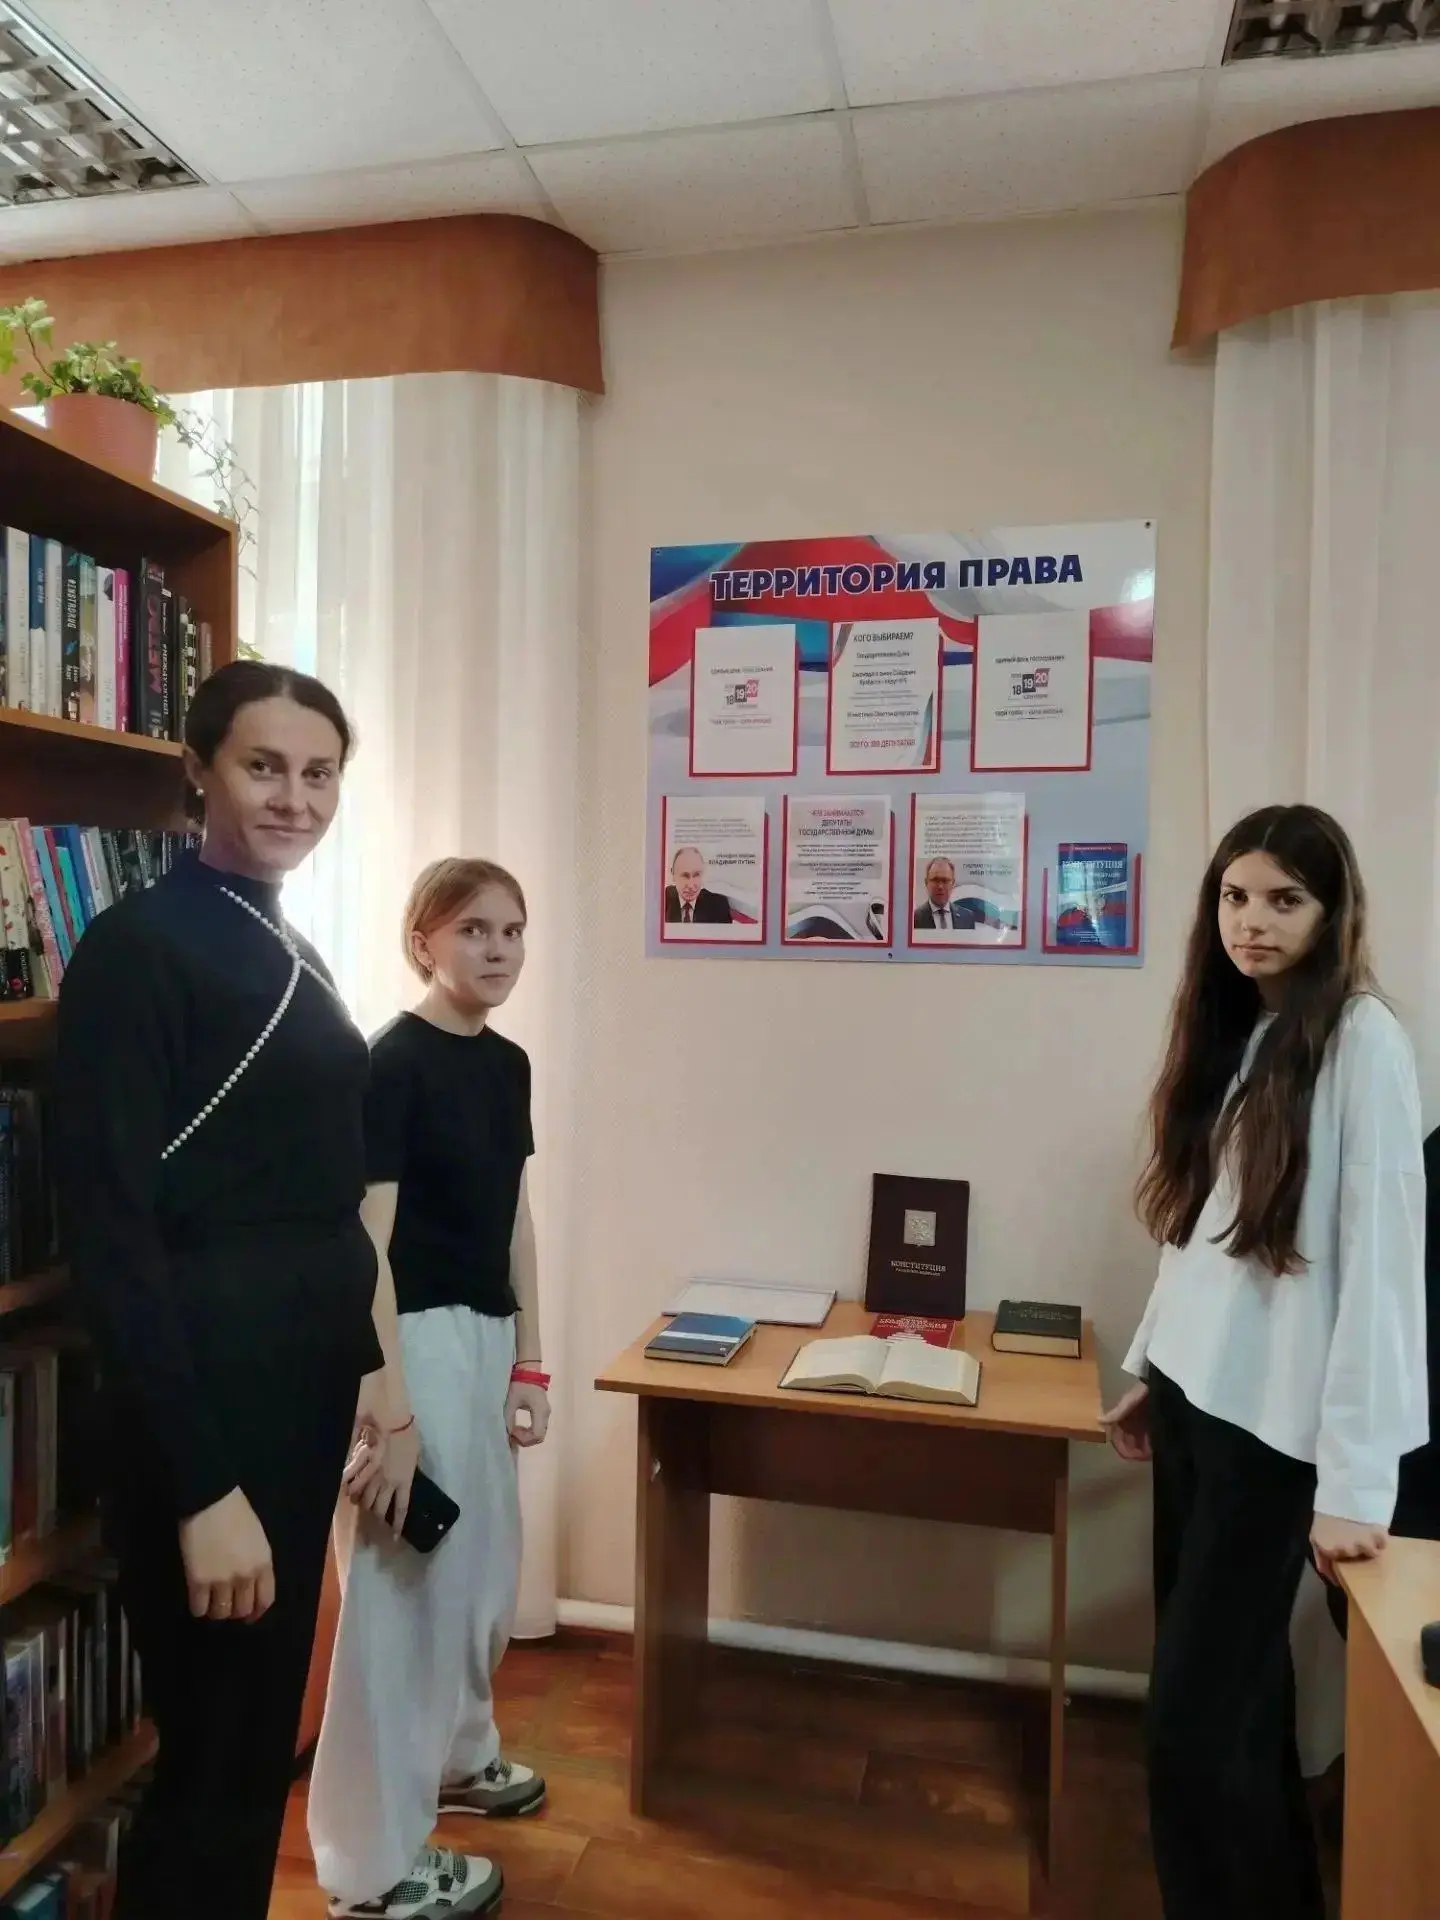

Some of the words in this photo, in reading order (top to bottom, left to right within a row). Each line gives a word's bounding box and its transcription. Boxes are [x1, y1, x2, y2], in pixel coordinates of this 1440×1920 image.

[711, 560, 946, 600] ТЕРРИТОРИЯ
[959, 554, 1083, 588] ПРАВА
[854, 633, 871, 642] КОГО
[872, 632, 914, 641] ВЫБИРАЕМ?
[736, 689, 745, 699] 19
[747, 682, 757, 693] 20
[1013, 684, 1021, 695] 18
[1023, 678, 1033, 688] 19
[1036, 672, 1047, 683] 20
[856, 827, 874, 836] ДУМЫ
